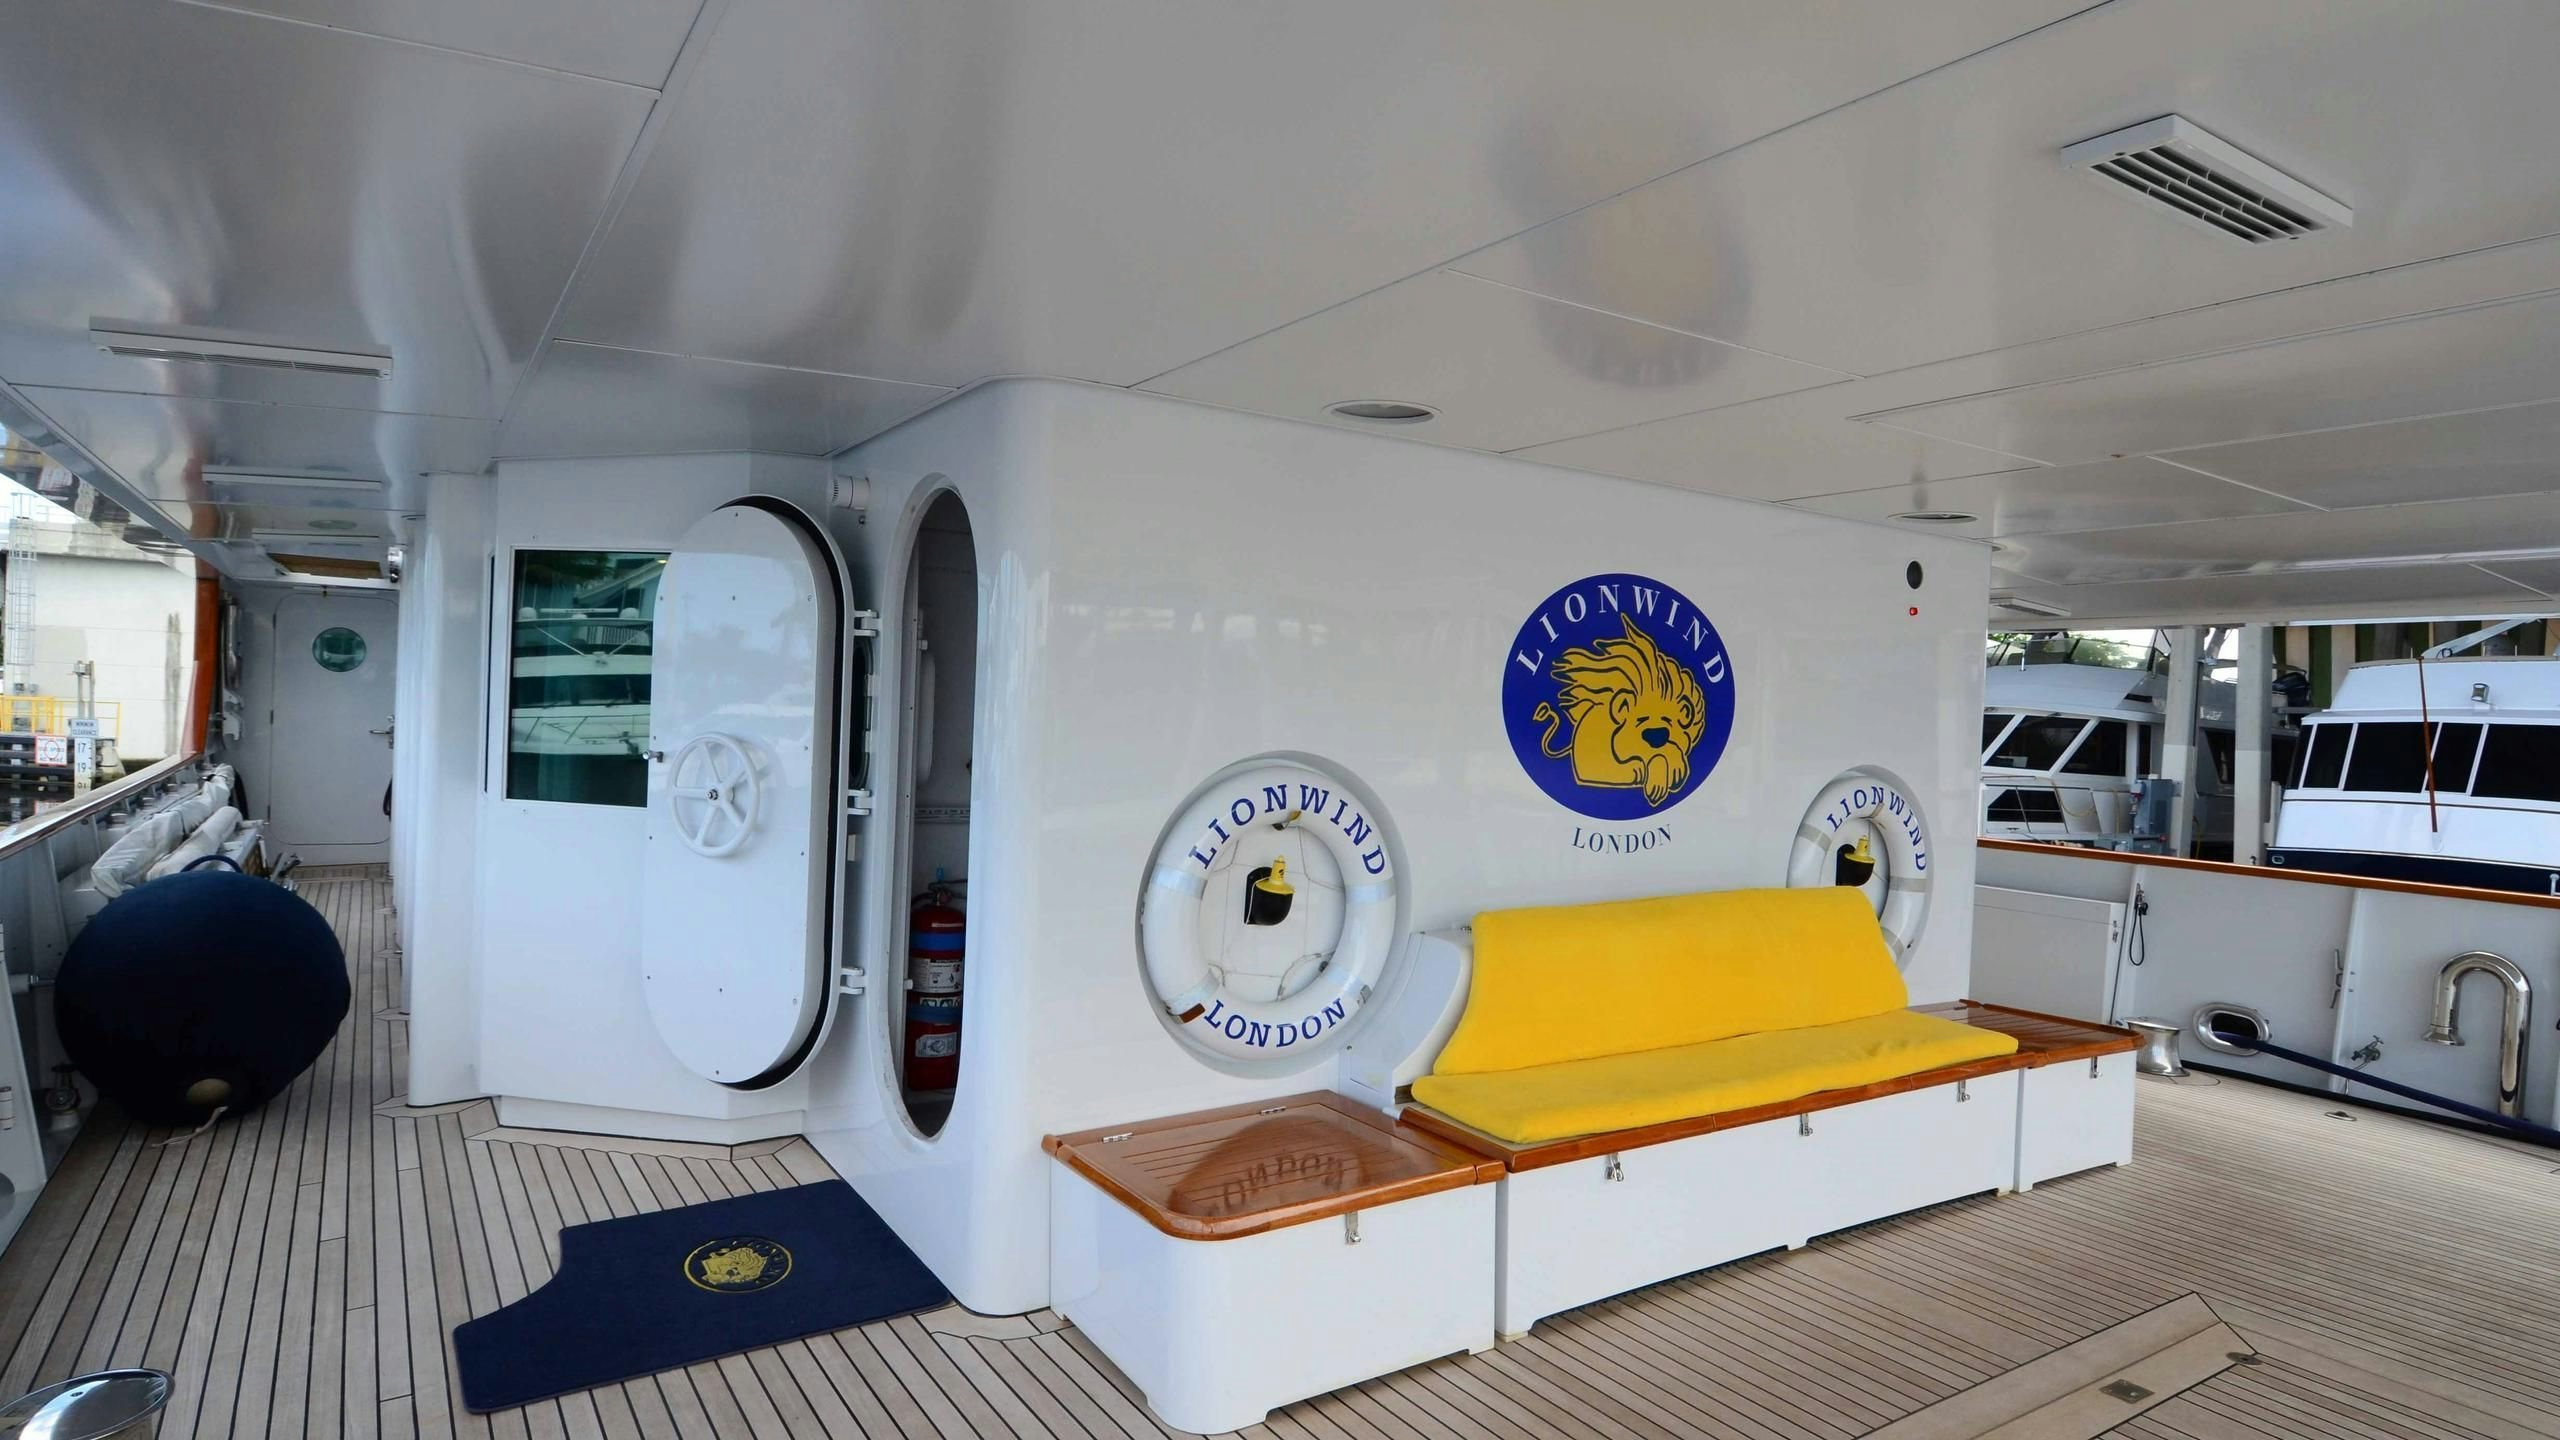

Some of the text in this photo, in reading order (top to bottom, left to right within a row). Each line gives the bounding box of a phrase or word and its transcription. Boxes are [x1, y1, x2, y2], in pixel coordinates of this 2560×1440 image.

[1516, 584, 1726, 685] LIONWIND
[77, 743, 88, 753] 17
[1189, 784, 1386, 876] LIONWIND
[1572, 823, 1672, 854] LONDON
[1826, 786, 1927, 871] LIONWIND
[1204, 997, 1345, 1048] LONDON
